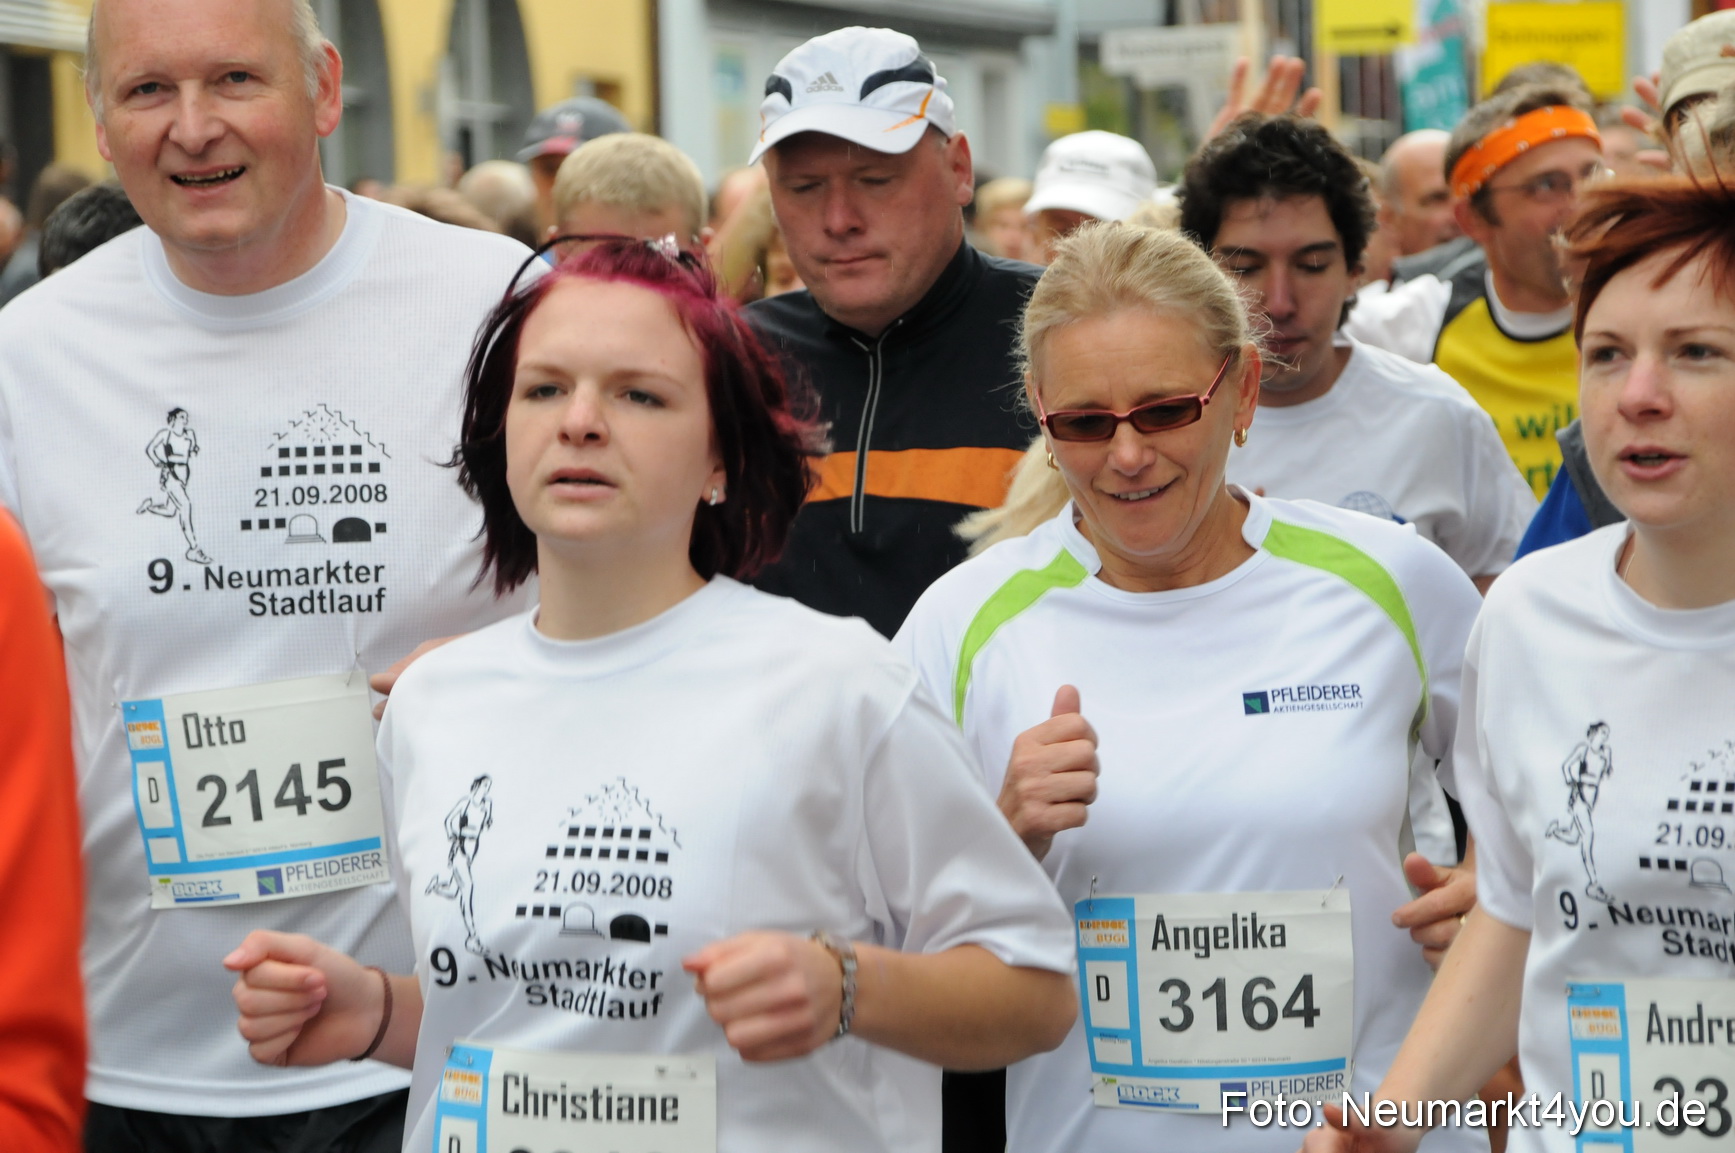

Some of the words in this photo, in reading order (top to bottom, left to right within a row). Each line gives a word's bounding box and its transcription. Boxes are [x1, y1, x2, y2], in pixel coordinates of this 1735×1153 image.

[806, 84, 844, 93] adidas
[255, 484, 388, 507] 21.09.2008
[204, 560, 385, 590] Neumarkter
[249, 588, 386, 616] Stadtlauf
[1271, 684, 1362, 703] PFLEIDERER
[1273, 702, 1363, 713] AKTIENGESELLSCHAFT
[182, 713, 246, 749] Otto
[148, 777, 159, 803] D
[196, 758, 352, 828] 2145
[1655, 822, 1735, 849] 21.09.
[286, 852, 382, 882] PFLEIDERER
[287, 870, 385, 894] AKTIENGESELLSCHAFT
[172, 880, 223, 897] BOCK
[533, 869, 672, 900] 21.09.2008
[1607, 902, 1735, 936] Neumar
[1151, 912, 1287, 958] Angelika
[484, 954, 663, 990] Neumarkter
[525, 983, 663, 1020] Stadtlauf
[1095, 975, 1111, 1002] D
[1158, 973, 1321, 1033] 3164
[502, 1070, 679, 1124] Christiane
[1117, 1084, 1181, 1103] BOCK
[1251, 1073, 1345, 1097] PFLEIDERER
[1591, 1069, 1605, 1101] D
[1653, 1076, 1733, 1138] 33
